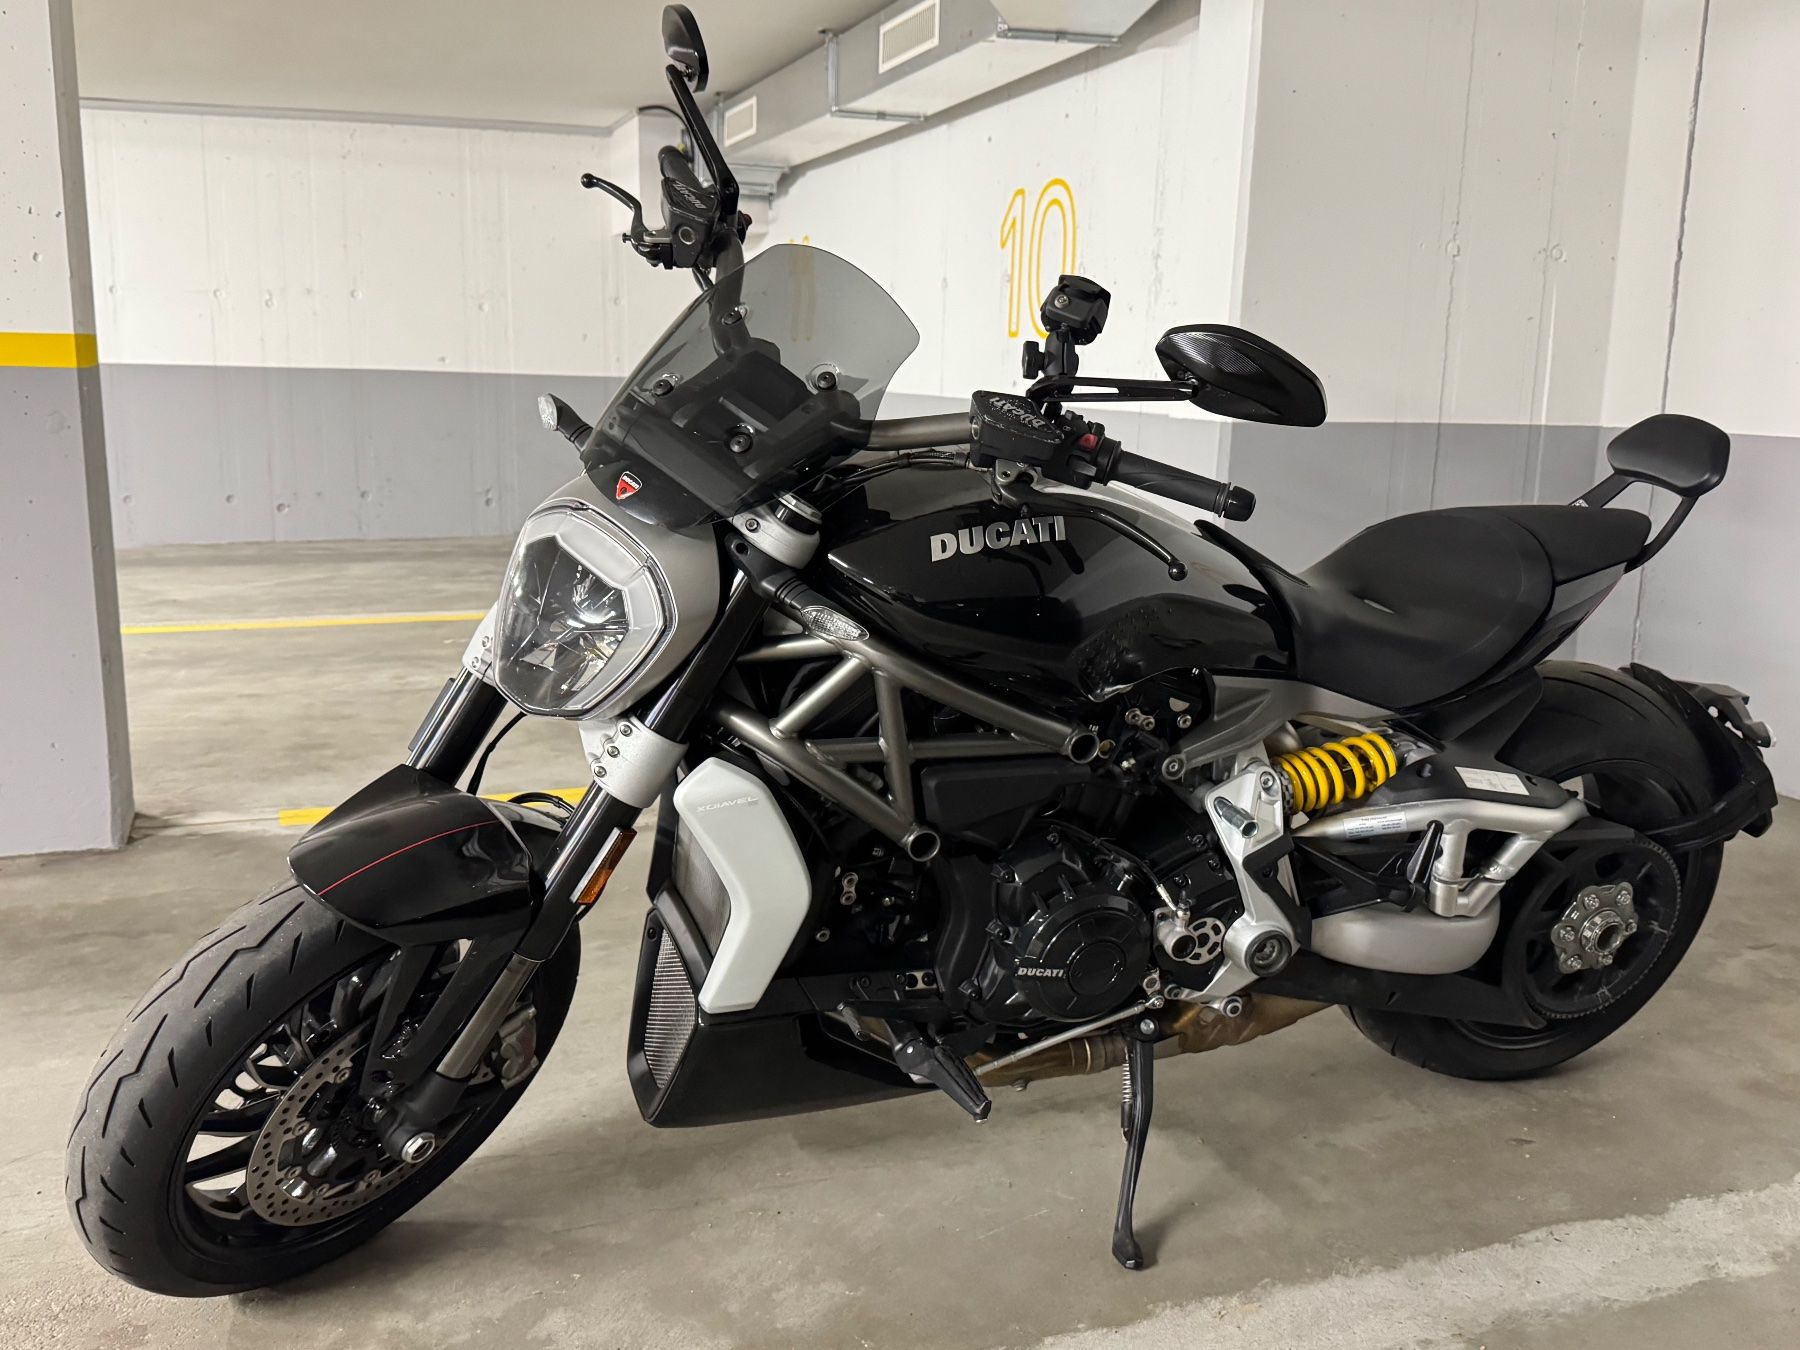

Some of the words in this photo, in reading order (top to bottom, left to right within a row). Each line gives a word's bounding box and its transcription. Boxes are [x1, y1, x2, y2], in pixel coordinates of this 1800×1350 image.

[1000, 178, 1076, 339] 10
[989, 397, 1045, 429] DUCATI
[930, 515, 1066, 562] DUCATI
[1017, 967, 1065, 978] DUCATI
